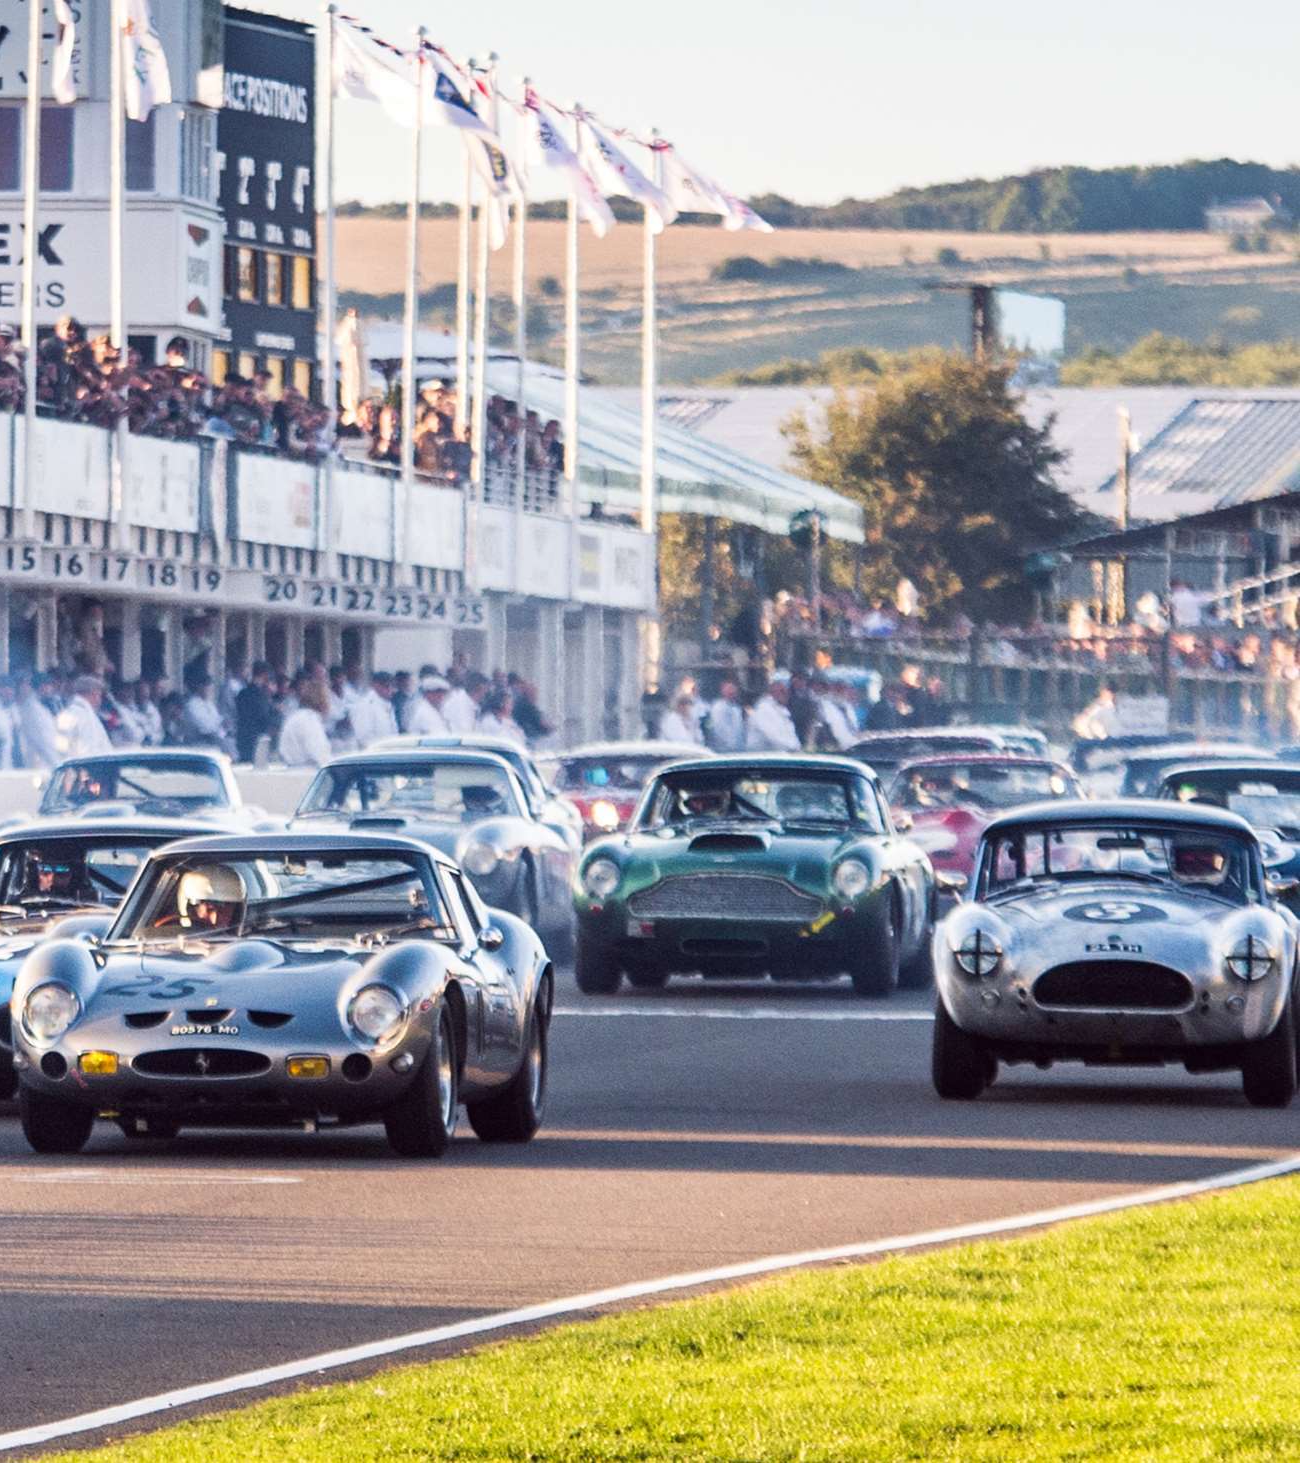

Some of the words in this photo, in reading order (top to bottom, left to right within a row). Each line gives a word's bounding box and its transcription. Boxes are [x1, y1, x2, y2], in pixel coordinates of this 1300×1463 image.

[226, 73, 245, 111] ACE
[247, 76, 308, 123] POSITIONS
[7, 547, 35, 571] 15
[53, 553, 83, 576] 16
[102, 558, 129, 581] 17
[147, 564, 176, 587] 18
[191, 570, 221, 591] 19
[266, 580, 297, 602] 20
[311, 584, 337, 607] 21
[345, 590, 374, 611] 22
[385, 594, 413, 616] 23
[418, 599, 446, 620] 24
[457, 603, 484, 624] 25
[103, 975, 214, 999] 25
